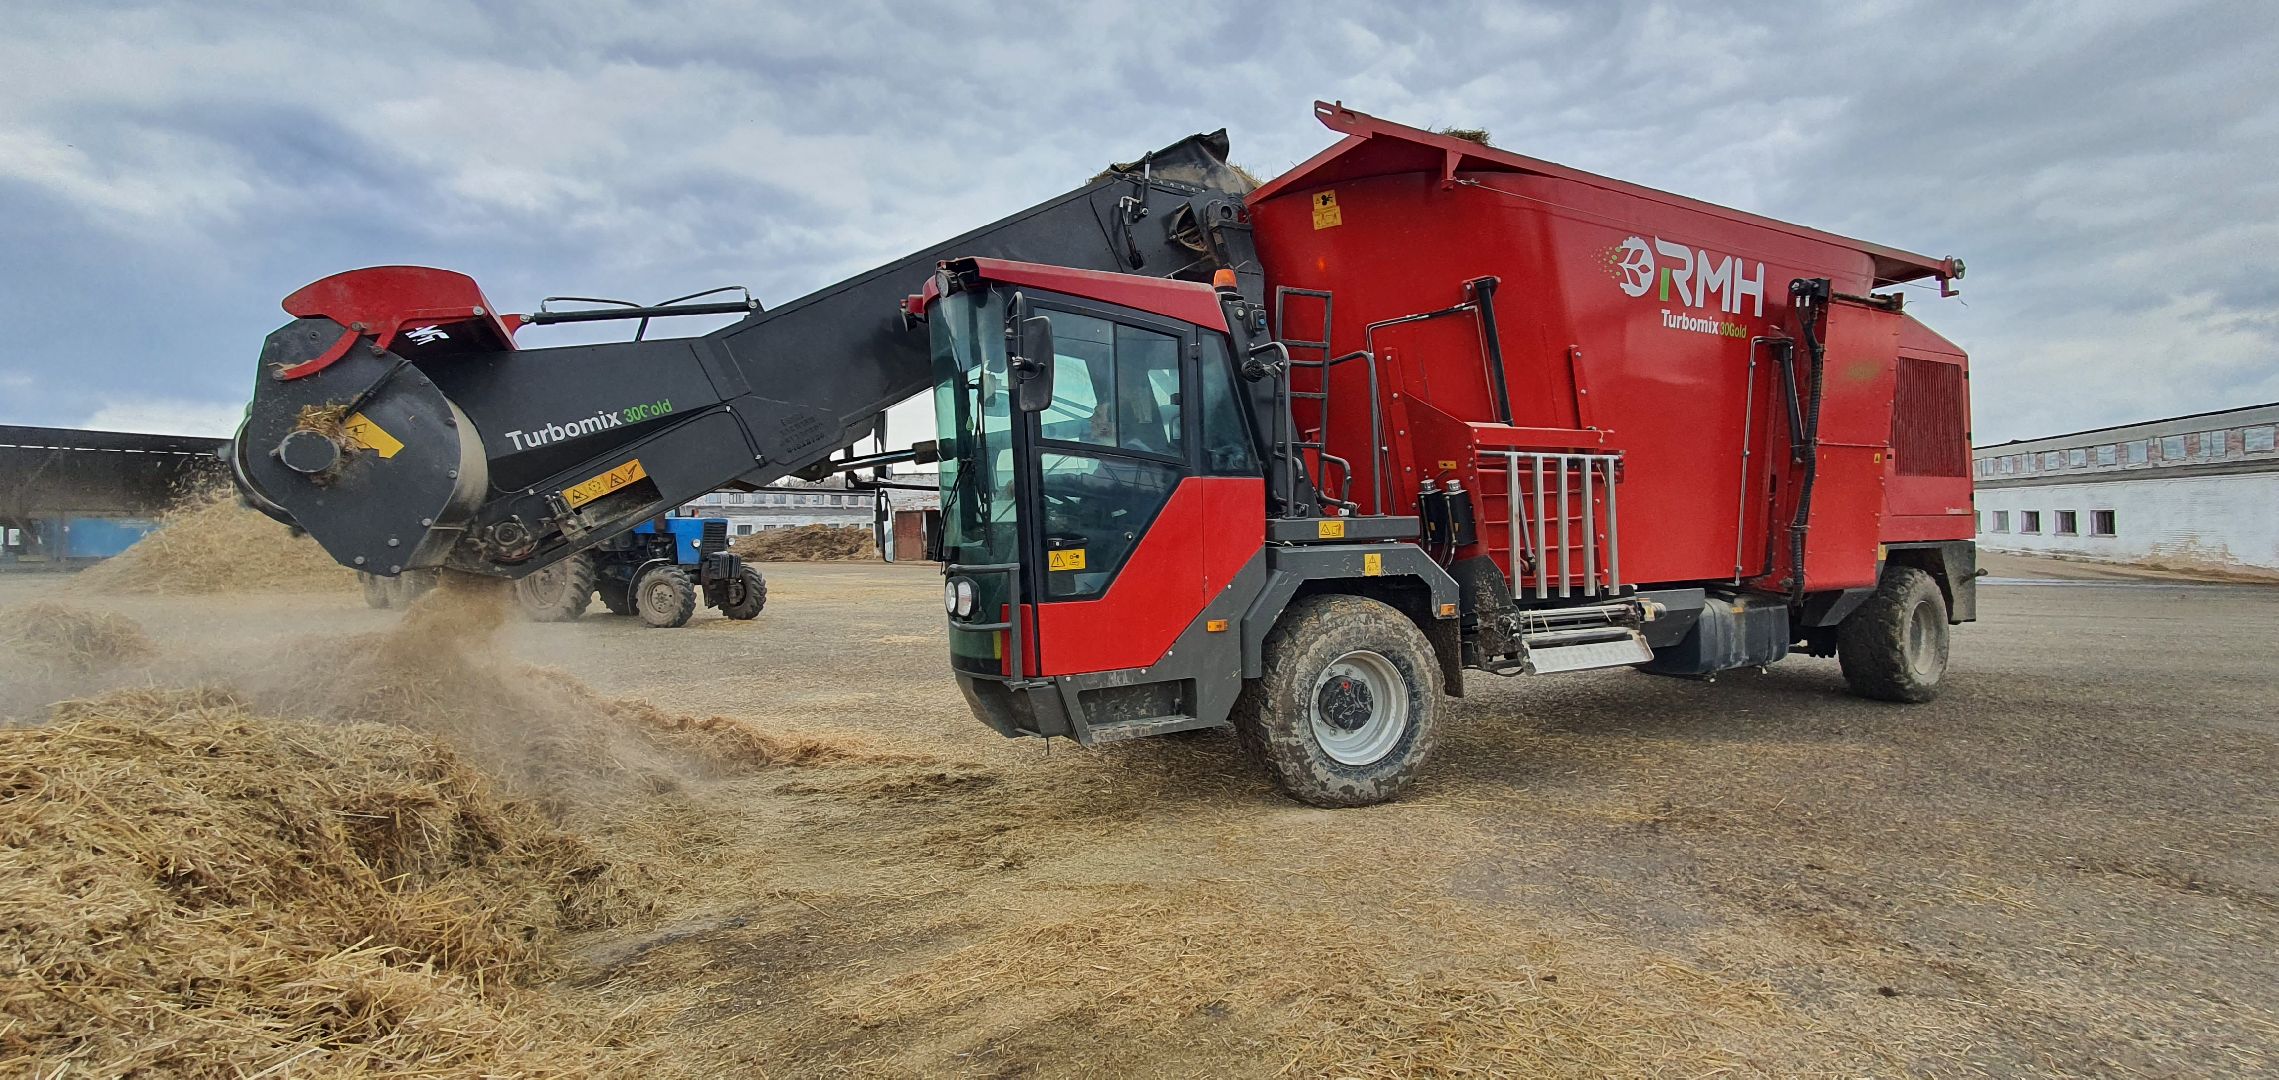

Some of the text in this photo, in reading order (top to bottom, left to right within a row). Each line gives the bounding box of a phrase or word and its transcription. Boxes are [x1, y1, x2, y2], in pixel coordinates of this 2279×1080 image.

[1655, 235, 1765, 318] RMH
[1661, 309, 1747, 339] Turbomix 30Gold
[505, 410, 622, 450] Turbomix
